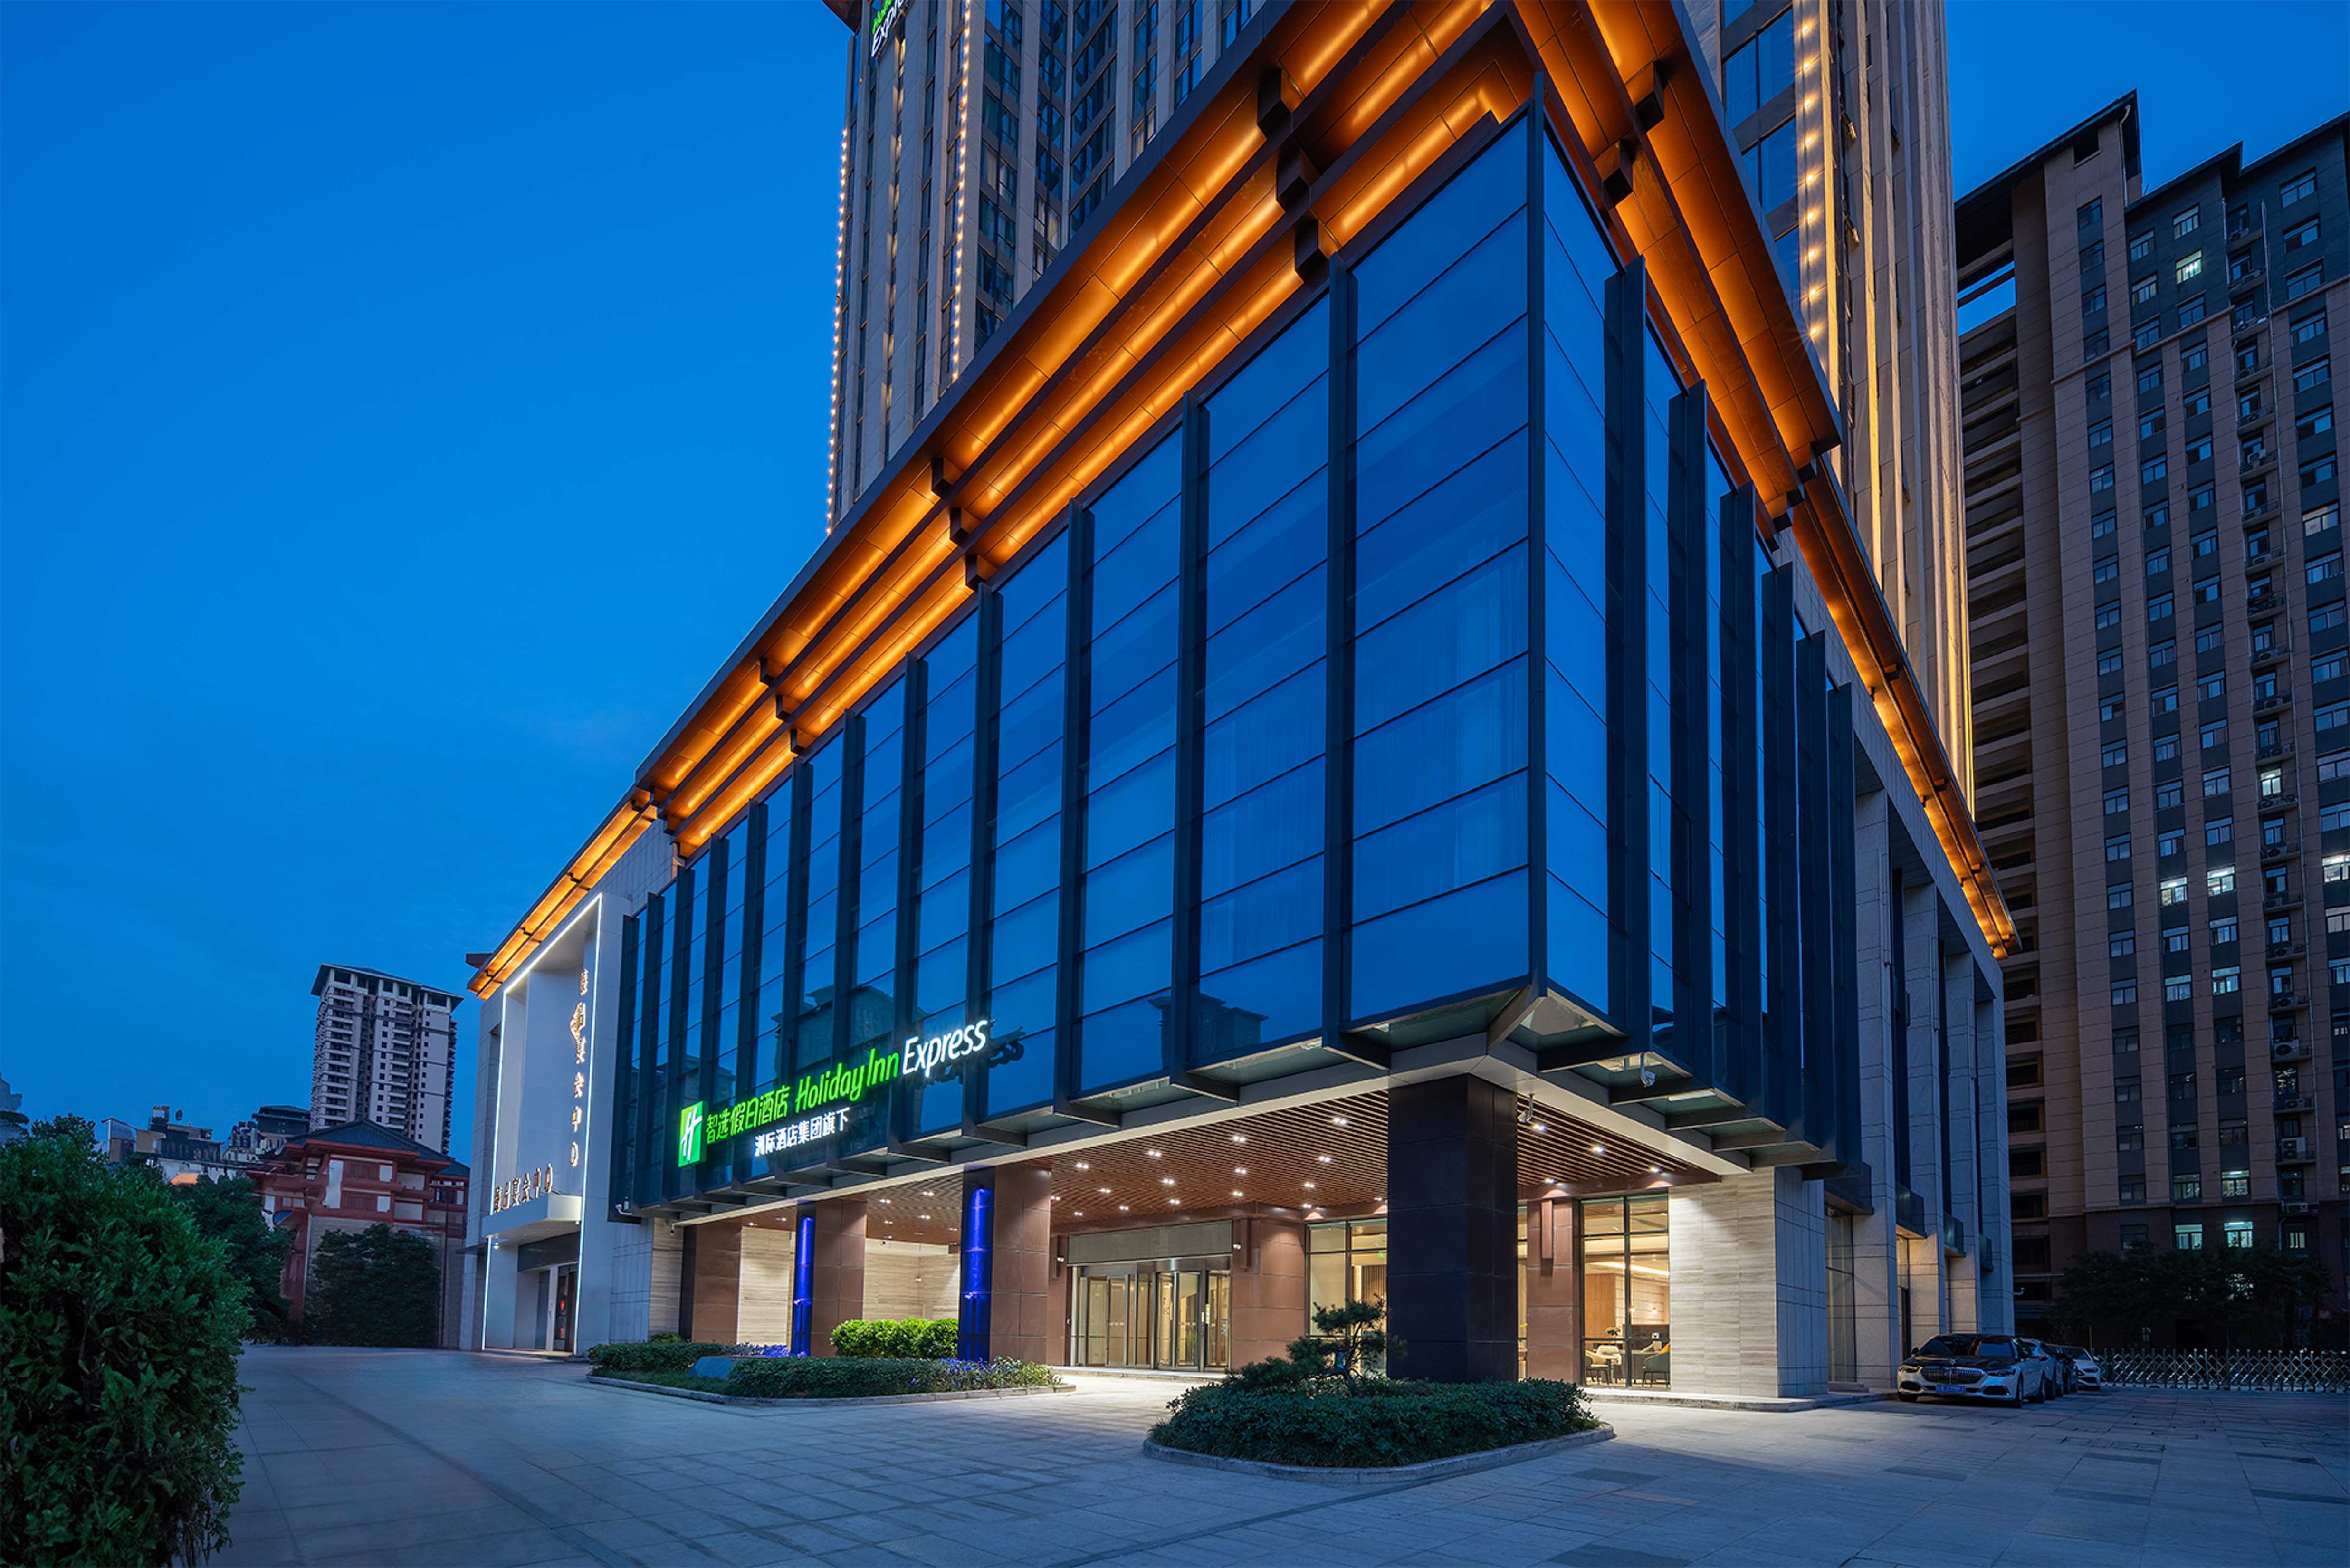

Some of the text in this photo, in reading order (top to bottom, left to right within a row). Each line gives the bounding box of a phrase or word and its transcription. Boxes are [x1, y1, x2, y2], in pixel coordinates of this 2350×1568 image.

[706, 1020, 988, 1144] 智选假日酒店 Holiday Inn Express
[755, 1107, 850, 1157] 洲际酒店集团旗下
